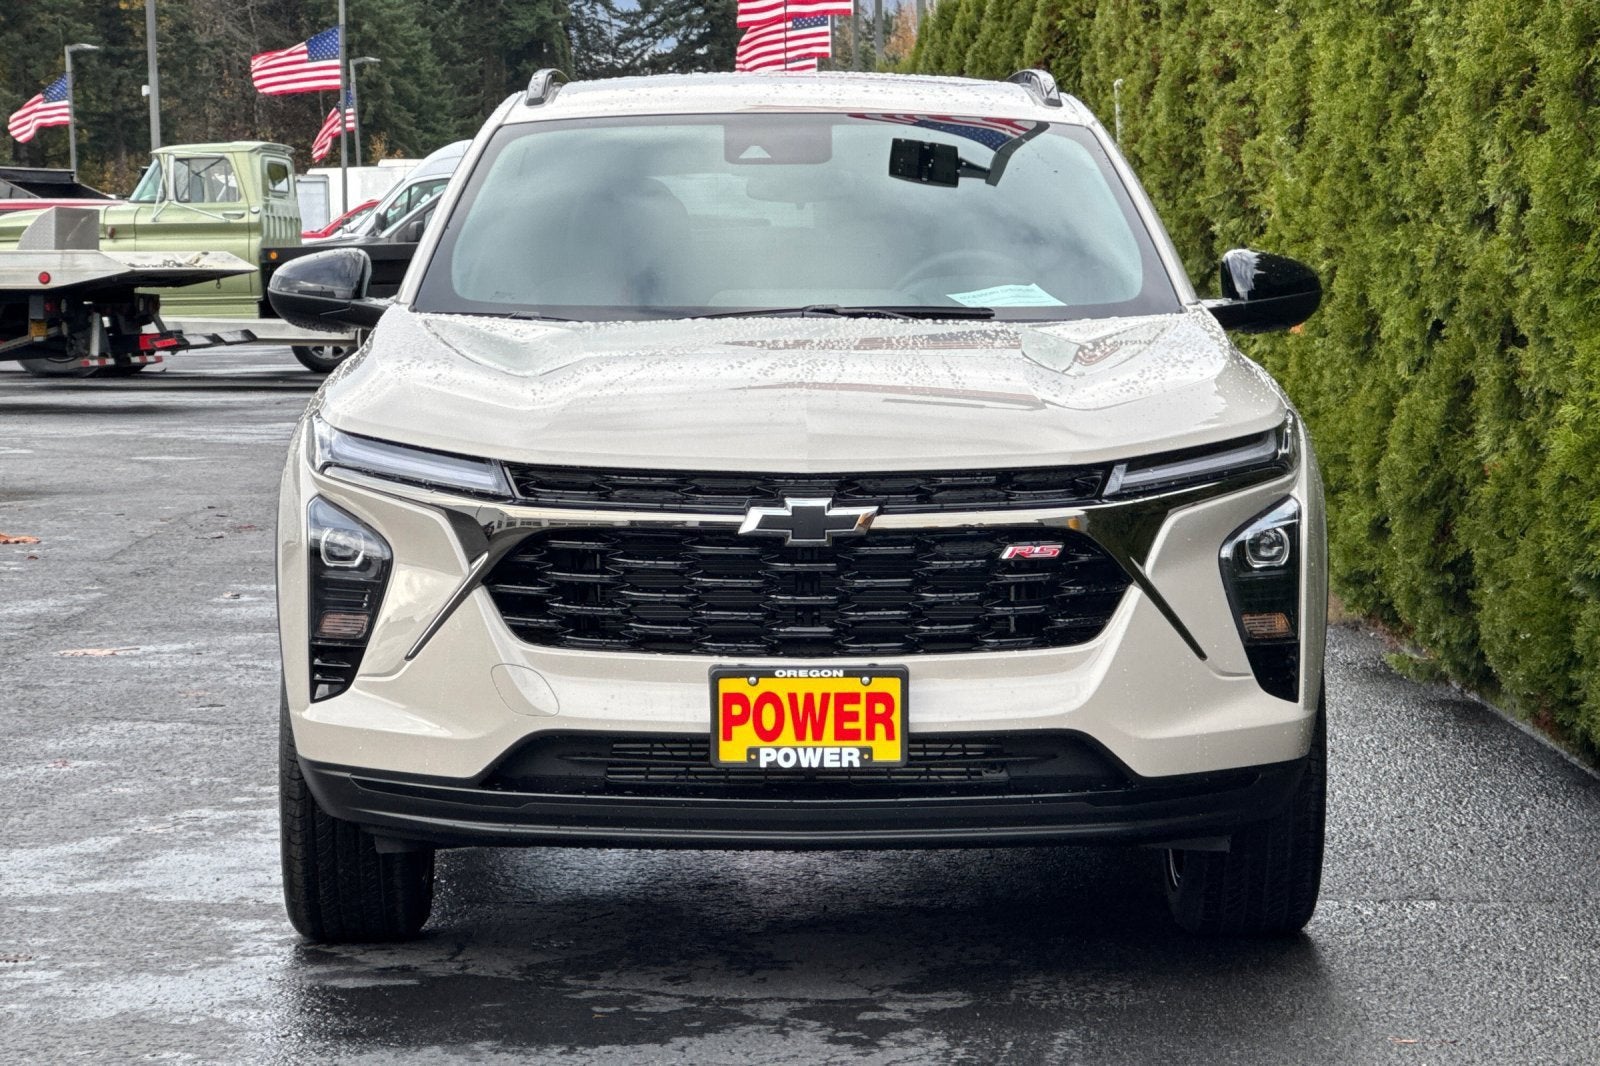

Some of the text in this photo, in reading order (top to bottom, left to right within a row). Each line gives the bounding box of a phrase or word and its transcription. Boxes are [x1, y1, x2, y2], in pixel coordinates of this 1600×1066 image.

[1001, 544, 1063, 559] RS
[774, 669, 844, 678] OREGON
[722, 691, 896, 742] POWER
[759, 747, 861, 768] POWER
